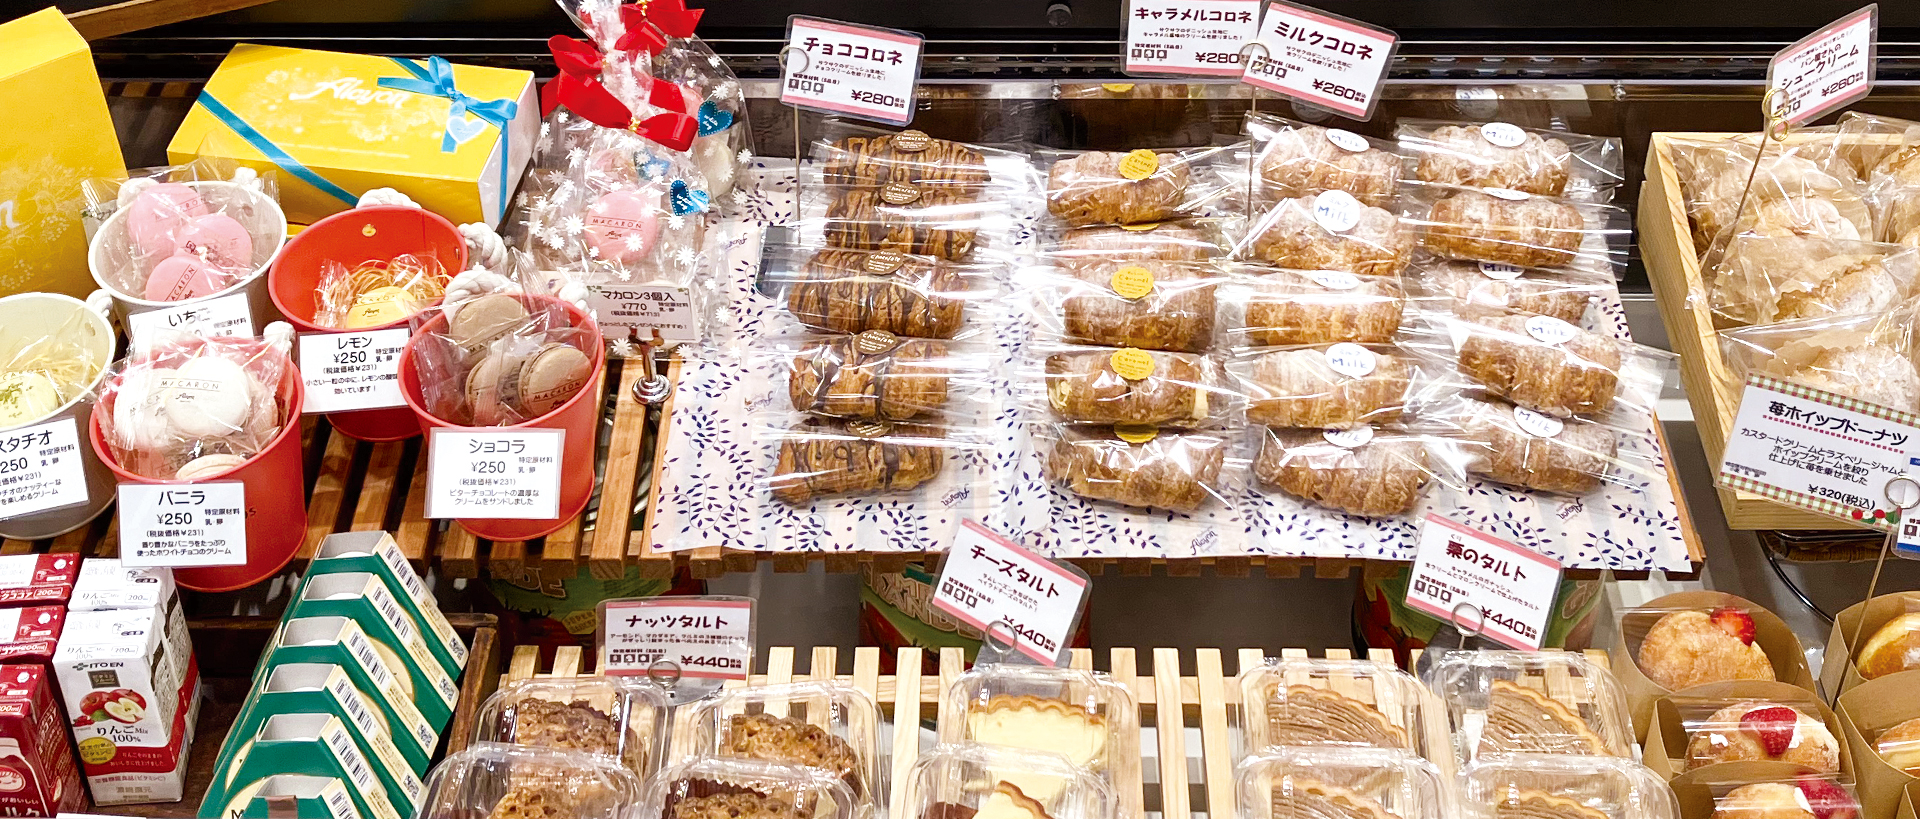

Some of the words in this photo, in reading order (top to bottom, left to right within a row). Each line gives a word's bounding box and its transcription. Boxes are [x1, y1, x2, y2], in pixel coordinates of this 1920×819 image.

[1135, 7, 1252, 24] キャラメルコロネ
[1274, 21, 1373, 60] ミルクコロネ
[803, 37, 903, 66] チョココロネ
[1782, 44, 1859, 90] シュークリーム
[289, 77, 411, 109] Alcyon
[1312, 78, 1356, 100] ¥260
[851, 89, 894, 107] ¥280
[886, 185, 918, 195] Chocolate
[1317, 205, 1350, 225] Milk
[592, 217, 643, 230] MACARON
[870, 254, 901, 263] Chocolate
[600, 290, 676, 302] マカロン3個入
[622, 303, 648, 311] ¥770
[338, 337, 373, 350] レモン
[862, 333, 894, 344] Chocolate
[333, 350, 367, 364] ¥250
[533, 381, 581, 401] MACARON
[1768, 400, 1909, 446] 苺ホイップドーナツ
[469, 439, 526, 454] ショコラ
[471, 461, 506, 474] ¥250
[1768, 452, 1868, 486] 仕上げに苺を乗せました
[0, 471, 42, 487] 価格¥231)
[158, 490, 205, 506] バニラ
[157, 512, 193, 525] ¥250
[1445, 540, 1527, 582] 栗のタルト
[970, 544, 1060, 599] チーズタルト
[626, 614, 728, 630] ナッツタルト
[1480, 604, 1526, 636] ¥440
[681, 654, 729, 668] ¥440
[112, 734, 142, 743] 100%
